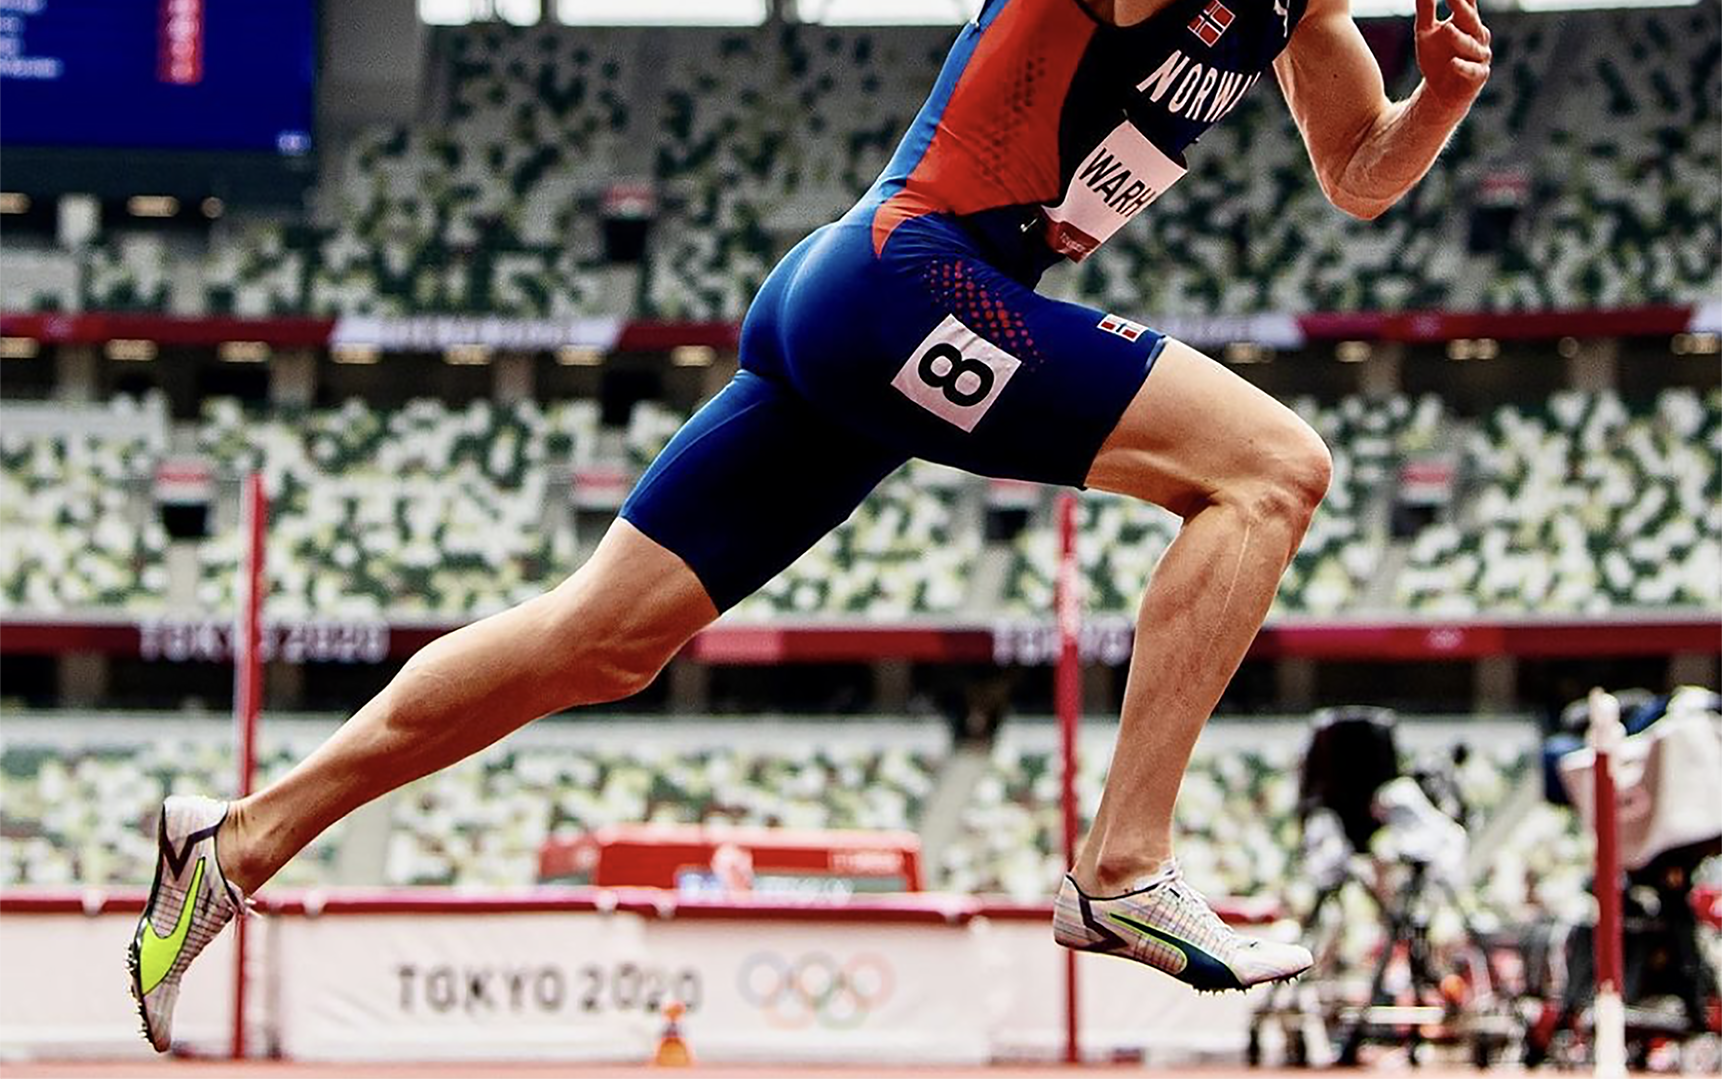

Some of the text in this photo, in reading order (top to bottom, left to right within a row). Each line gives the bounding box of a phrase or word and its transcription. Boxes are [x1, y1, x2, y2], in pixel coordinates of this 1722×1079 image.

[1136, 49, 1261, 122] NORW
[918, 343, 994, 407] 8
[397, 965, 566, 1013] TOKYO
